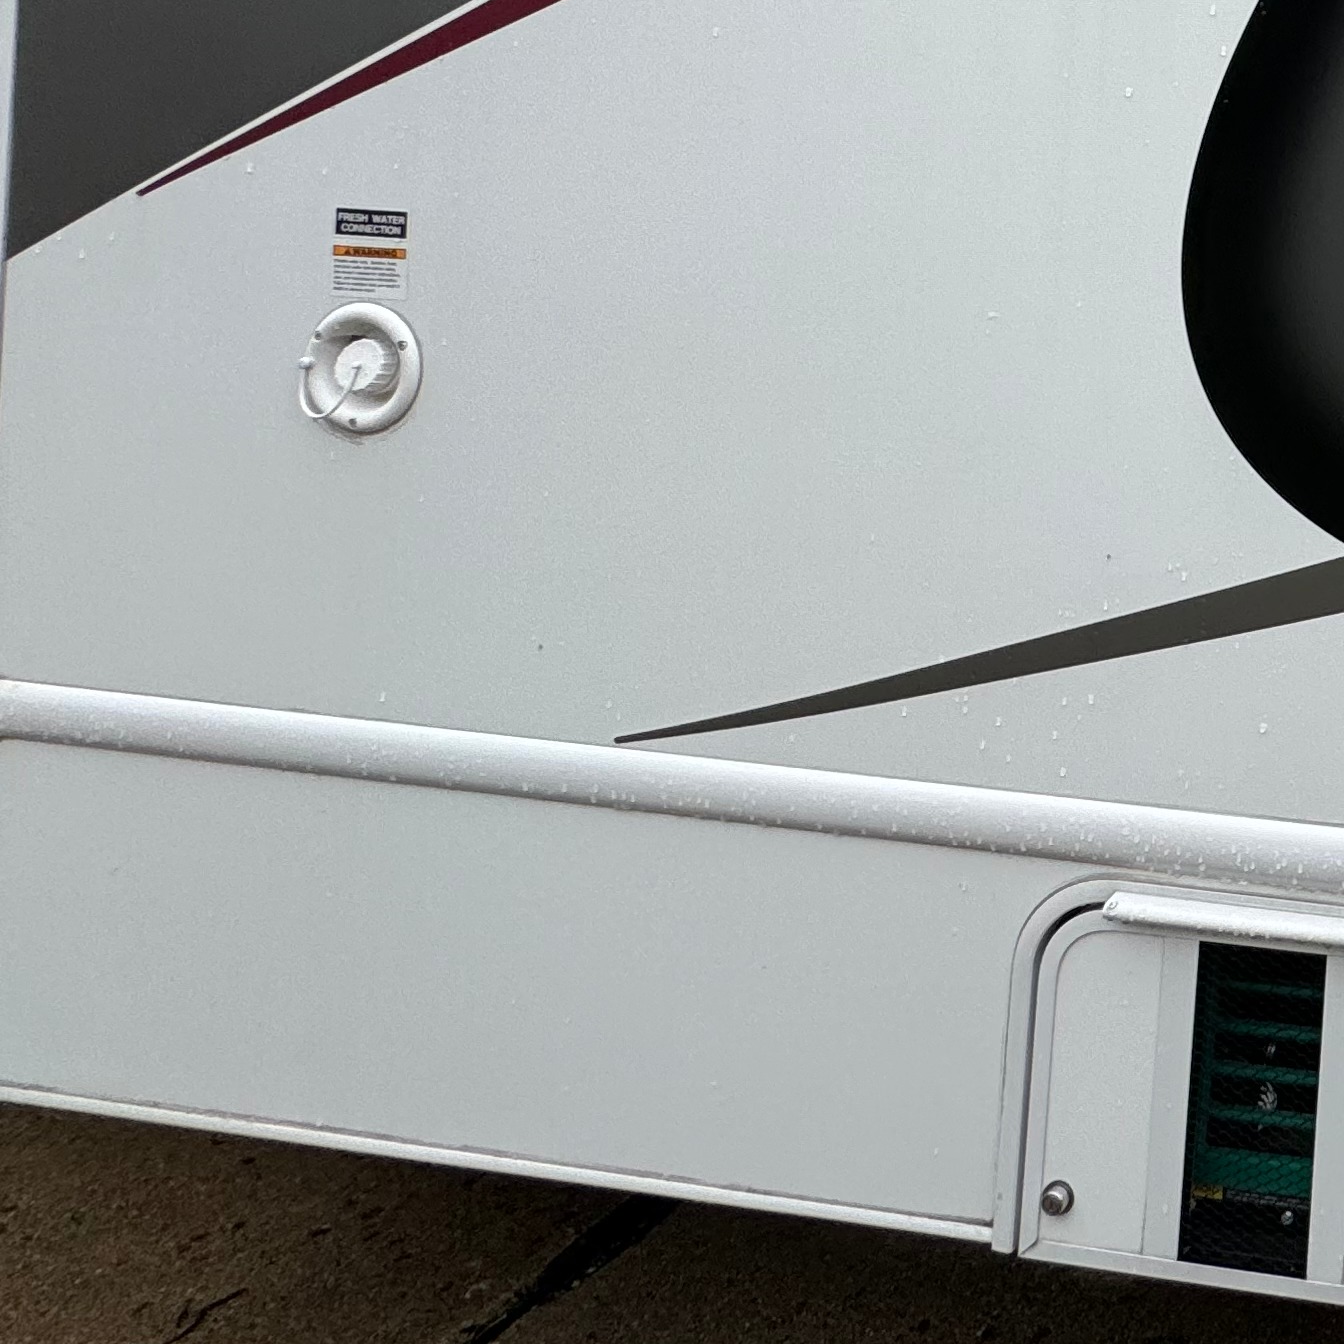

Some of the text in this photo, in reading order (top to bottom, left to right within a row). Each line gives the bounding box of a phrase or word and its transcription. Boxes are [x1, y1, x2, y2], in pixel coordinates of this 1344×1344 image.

[337, 212, 406, 225] FRESH WATER
[340, 222, 402, 235] CONNECTION
